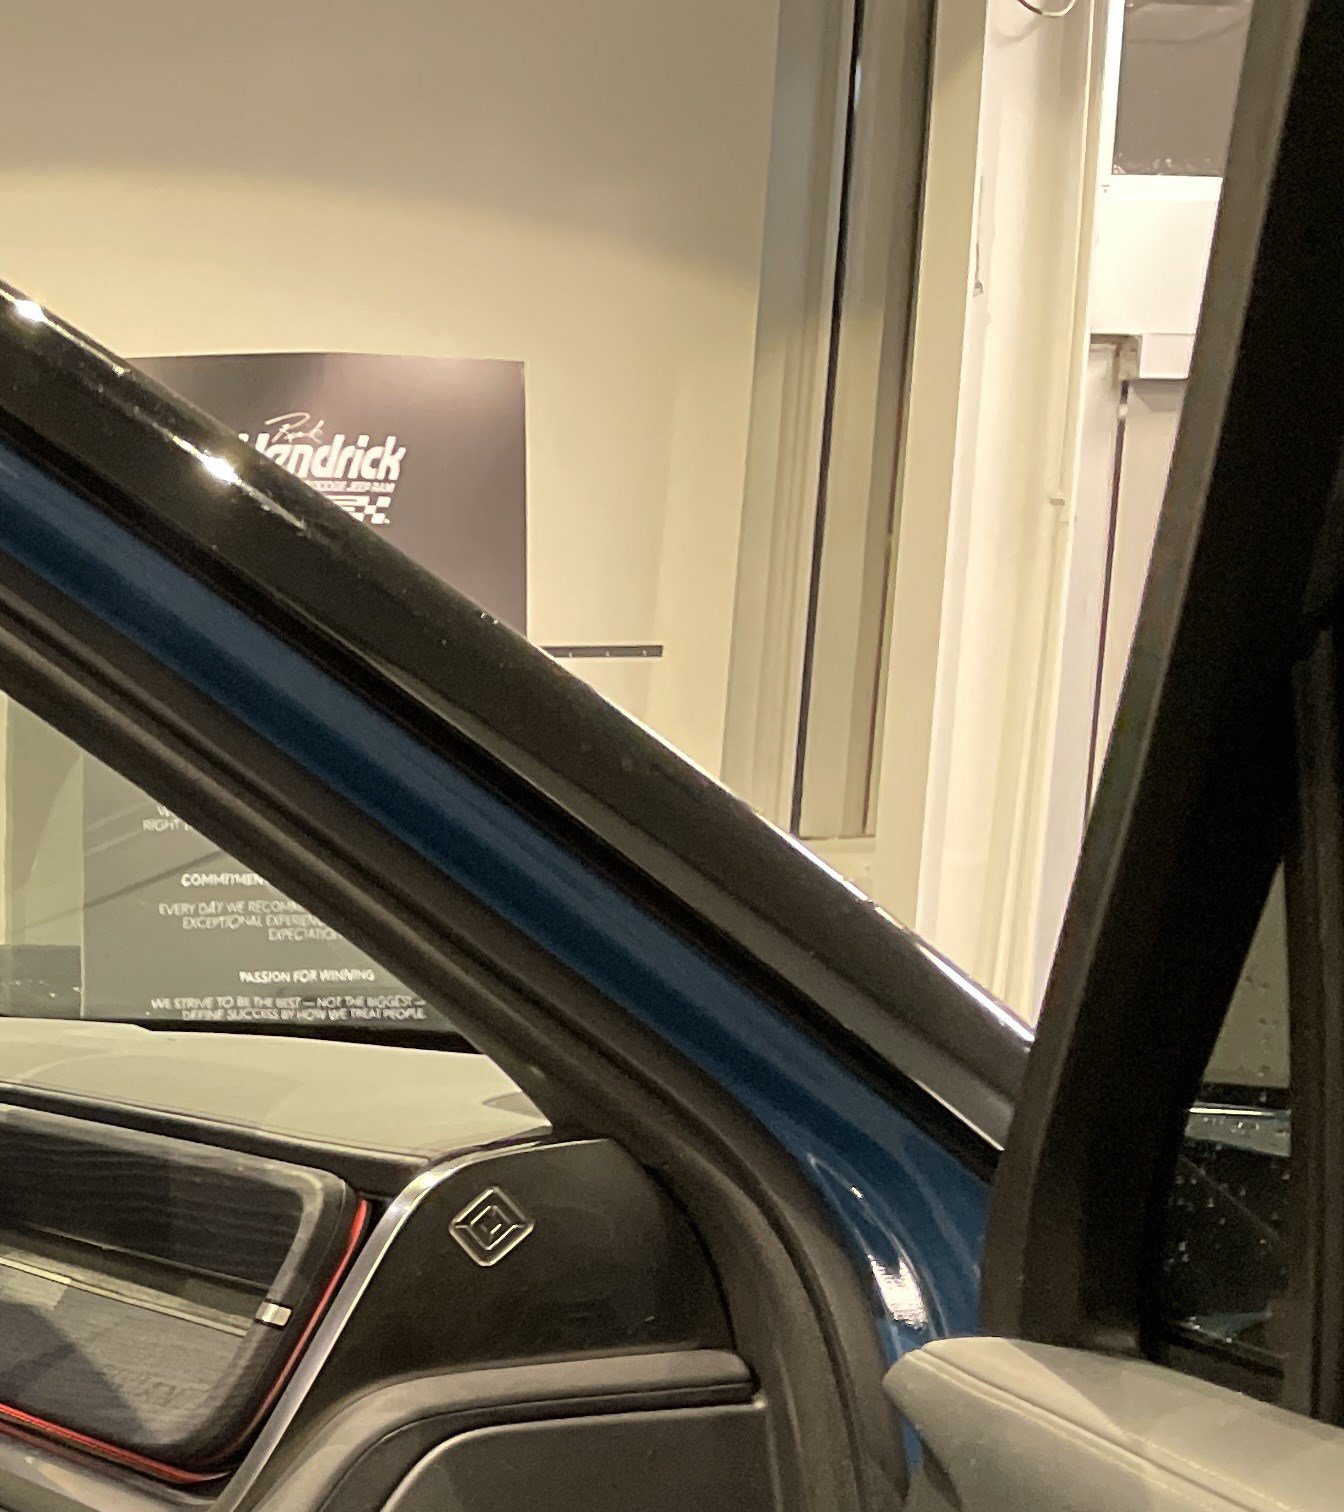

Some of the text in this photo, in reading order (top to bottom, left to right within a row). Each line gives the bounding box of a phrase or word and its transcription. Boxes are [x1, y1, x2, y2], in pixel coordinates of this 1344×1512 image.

[181, 872, 270, 887] COMMITMEN
[239, 969, 375, 984] PASSION FOR WINNING
[216, 996, 233, 1008] TO
